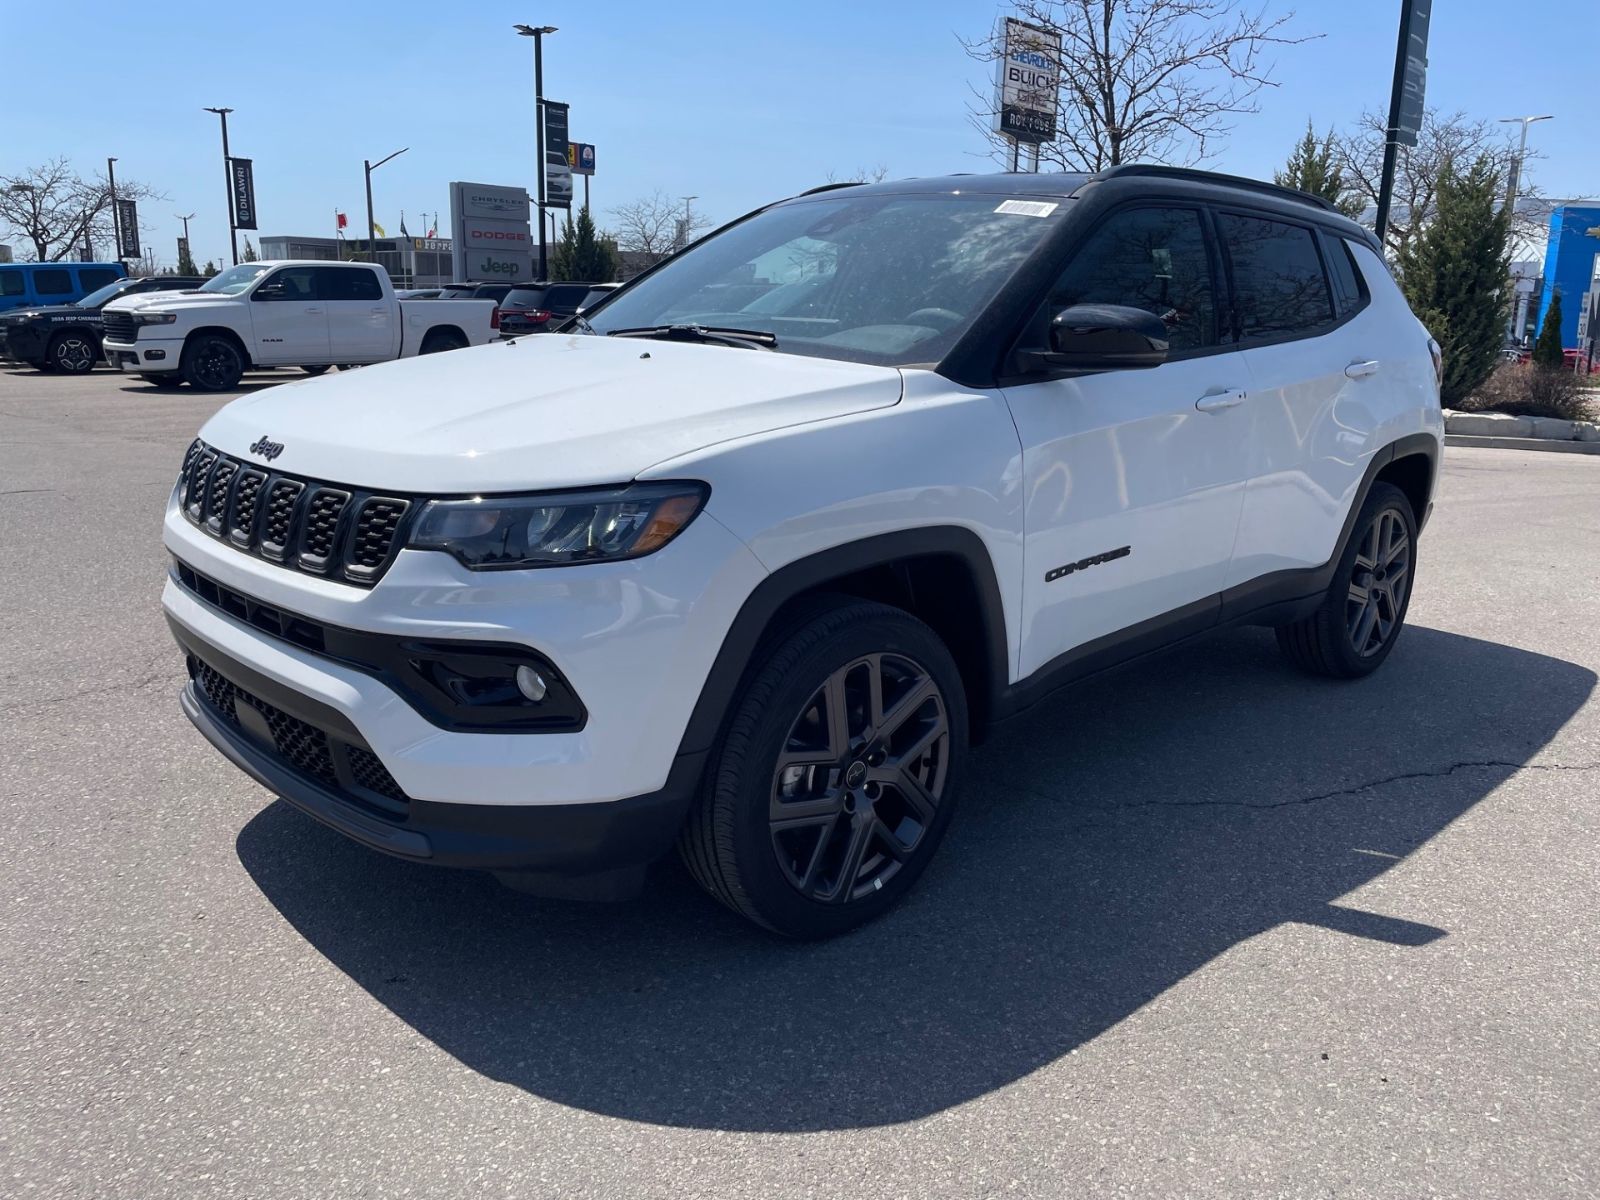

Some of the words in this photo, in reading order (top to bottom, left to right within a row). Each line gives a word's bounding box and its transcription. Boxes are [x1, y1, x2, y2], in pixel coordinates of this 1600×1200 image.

[1009, 67, 1056, 91] BUICK
[237, 167, 248, 209] DILAWRI
[471, 195, 525, 205] CHRYSLER
[471, 230, 526, 241] DODGE
[480, 257, 519, 276] Jeep
[249, 435, 285, 462] Jeep
[1045, 545, 1131, 582] COMPASS
